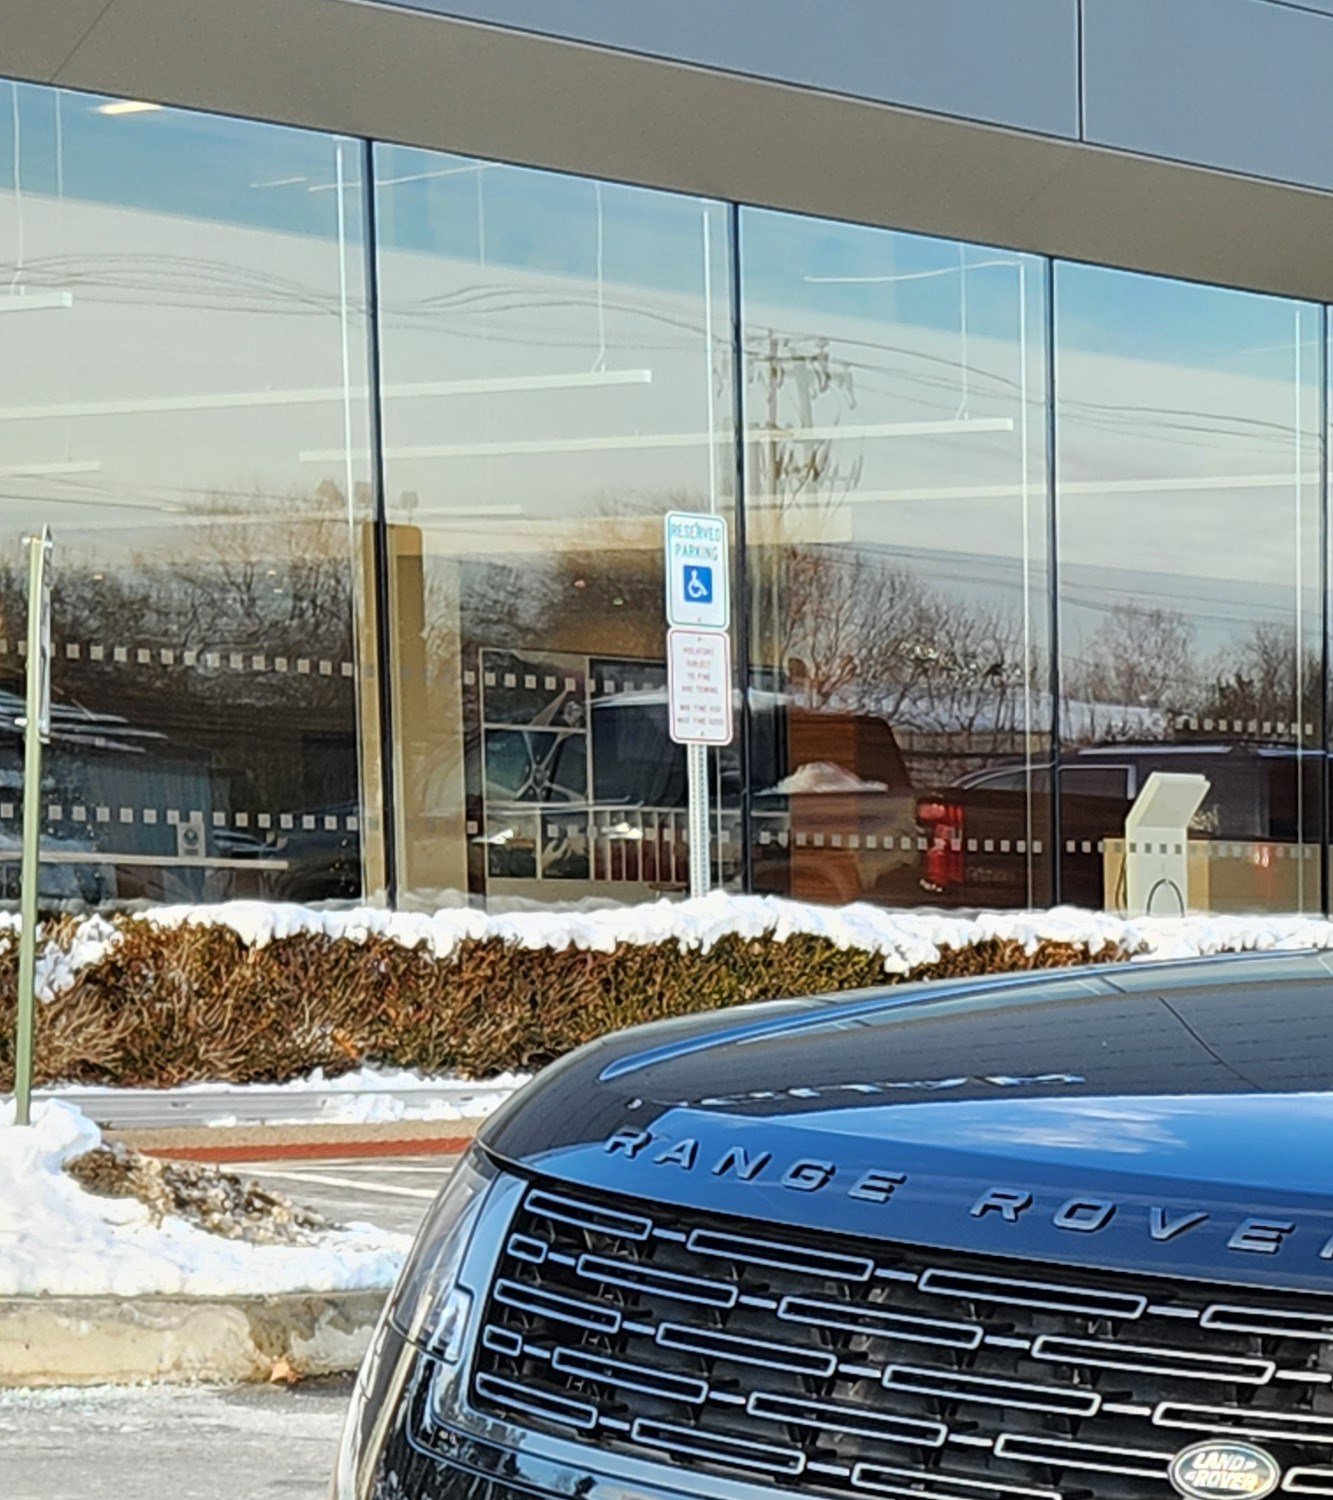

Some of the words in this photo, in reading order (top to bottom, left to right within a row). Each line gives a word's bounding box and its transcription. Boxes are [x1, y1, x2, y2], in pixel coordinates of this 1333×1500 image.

[671, 522, 720, 541] RESERVED
[675, 543, 718, 561] PARKING
[602, 1123, 906, 1205] RANGE
[1191, 1451, 1246, 1470] LAND
[1191, 1469, 1259, 1491] ROVER
